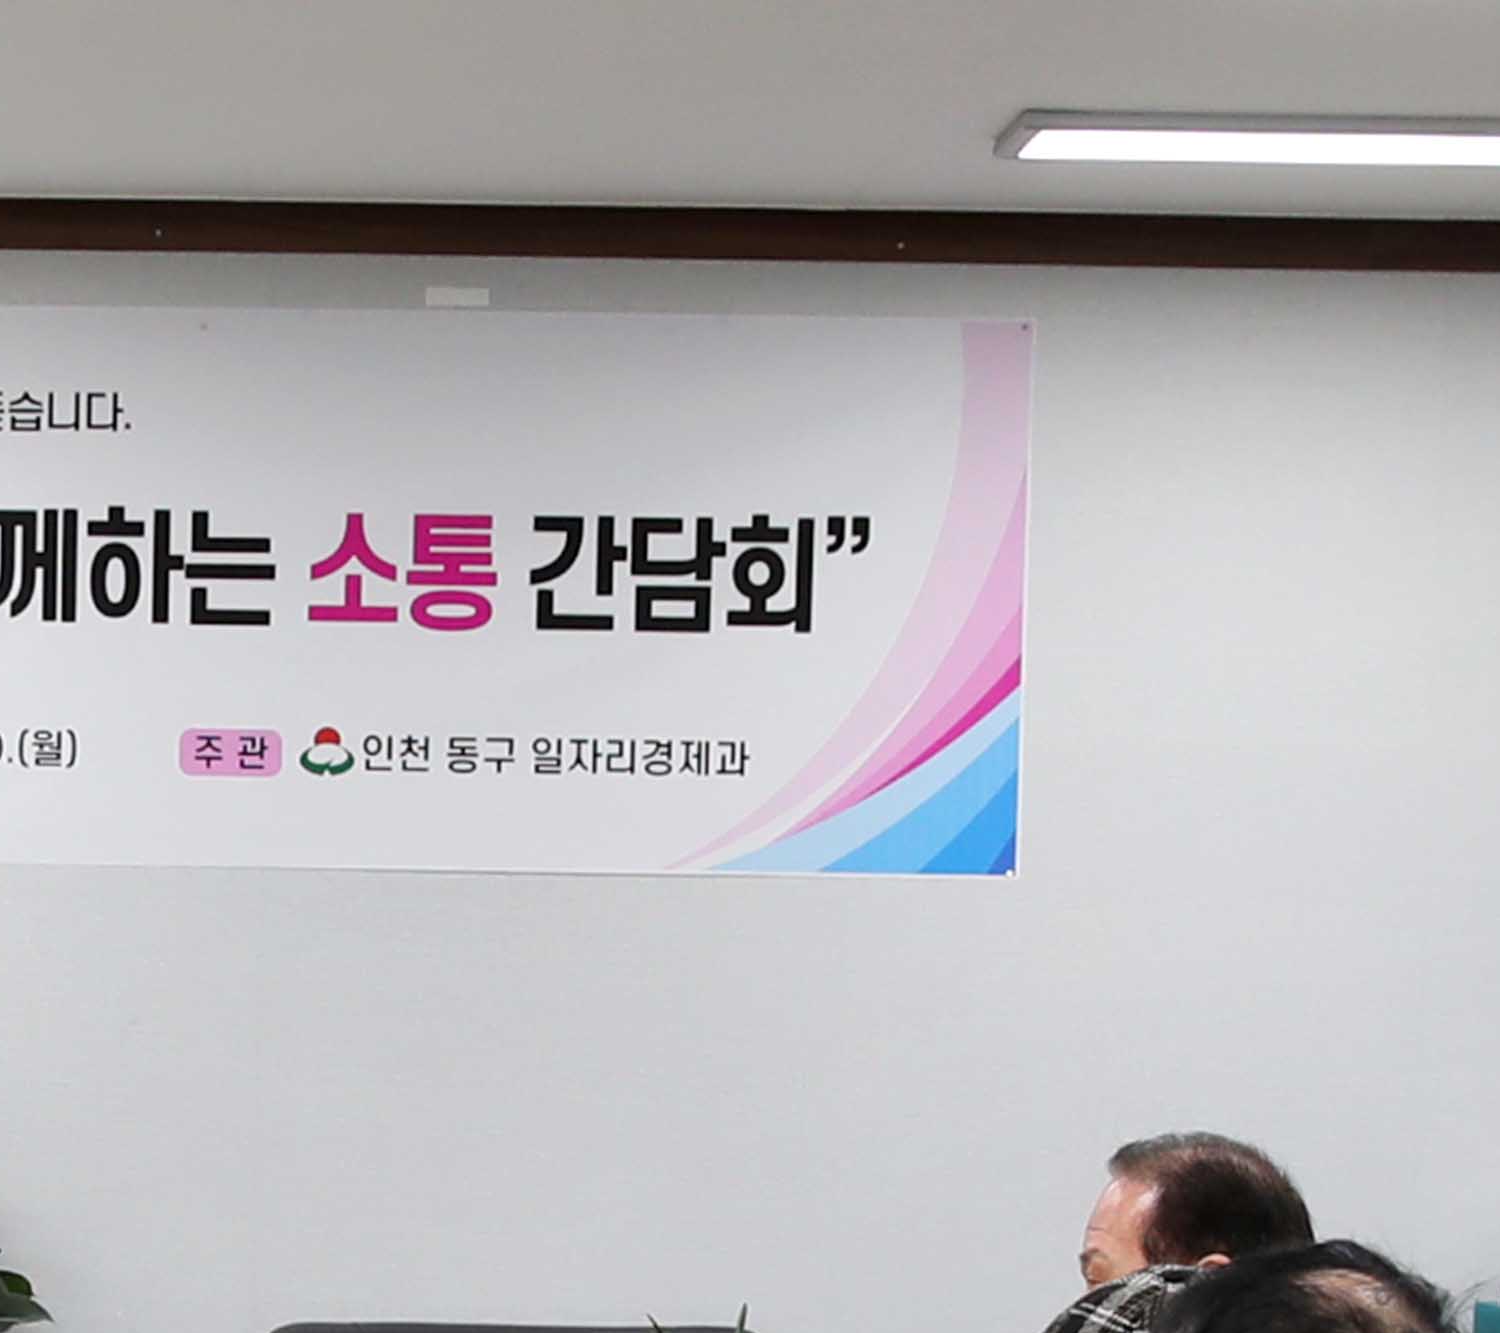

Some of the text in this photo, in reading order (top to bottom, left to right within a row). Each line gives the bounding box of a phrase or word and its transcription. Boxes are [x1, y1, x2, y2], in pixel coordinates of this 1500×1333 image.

[307, 512, 499, 632] 소통
[362, 734, 430, 773] 인천
[447, 736, 515, 774] 동구
[531, 737, 751, 778] 일자리경제과
